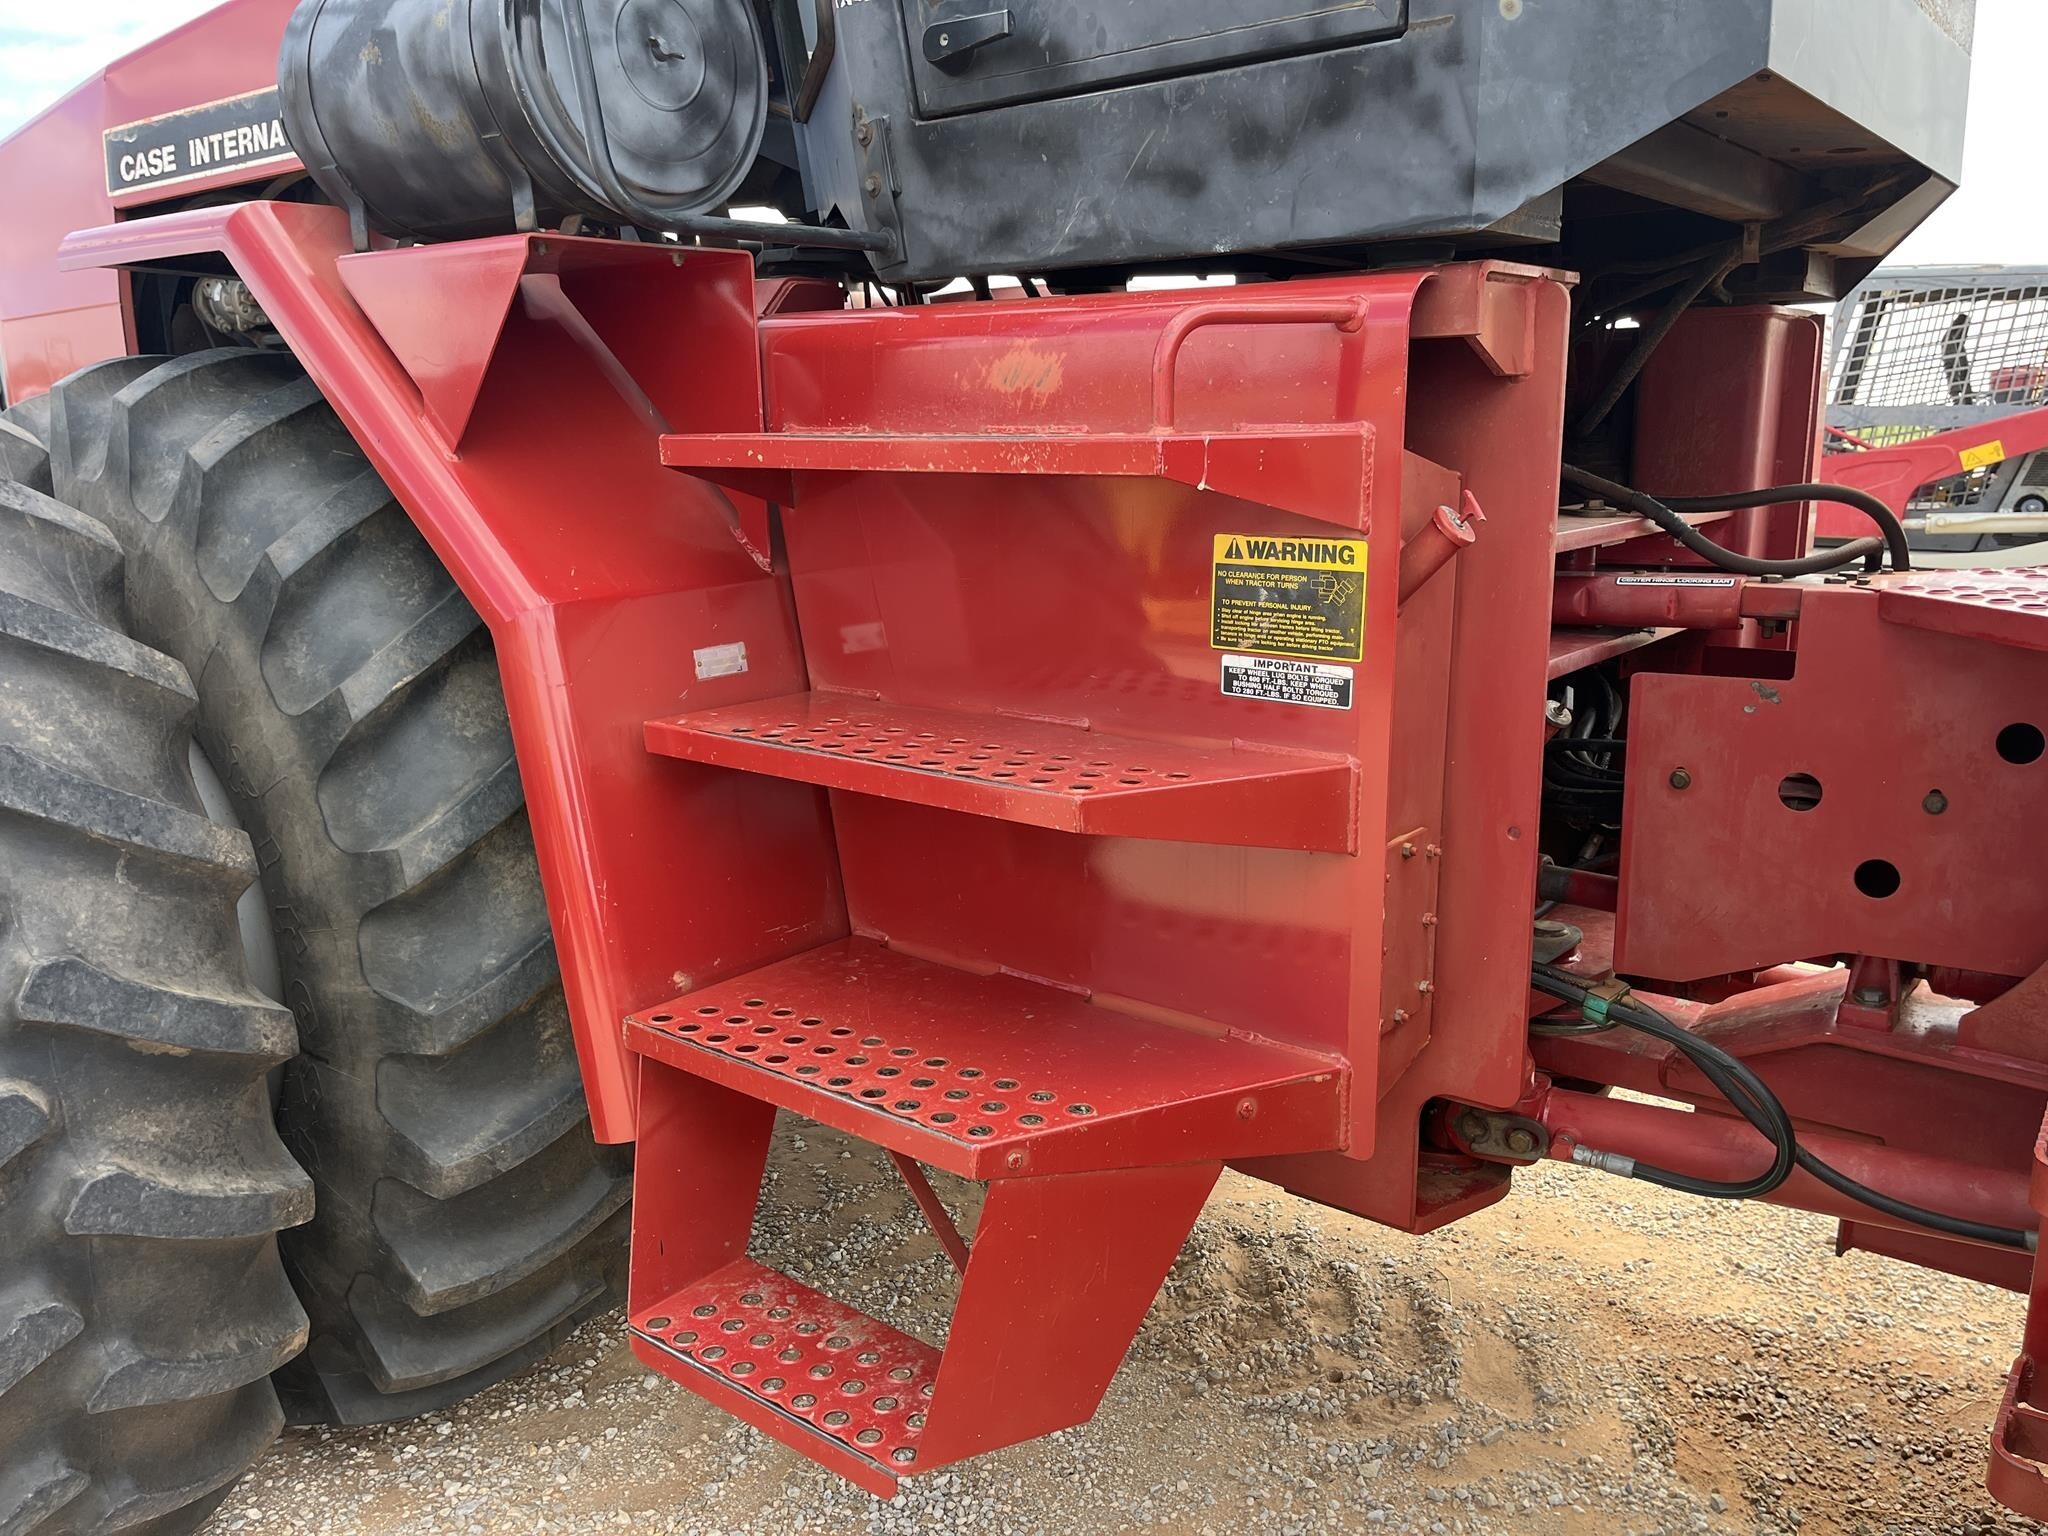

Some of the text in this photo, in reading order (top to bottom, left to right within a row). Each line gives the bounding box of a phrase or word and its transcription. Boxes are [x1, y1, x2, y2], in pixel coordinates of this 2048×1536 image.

[120, 144, 176, 182] CASE
[1246, 540, 1355, 565] WARNING
[1229, 571, 1265, 579] CLEARANCE
[1258, 602, 1288, 610] PERSONAL
[1254, 659, 1318, 674] IMPORTANT
[1248, 670, 1270, 678] WHEEL
[1288, 674, 1309, 682] BOLTS
[1311, 676, 1344, 685] TORQUED
[1290, 680, 1307, 688] KEEP
[1310, 682, 1333, 690] WHEEL
[1233, 680, 1262, 689] BUSHING
[1283, 686, 1303, 694] BOLTS
[1306, 688, 1338, 698] TORQUED
